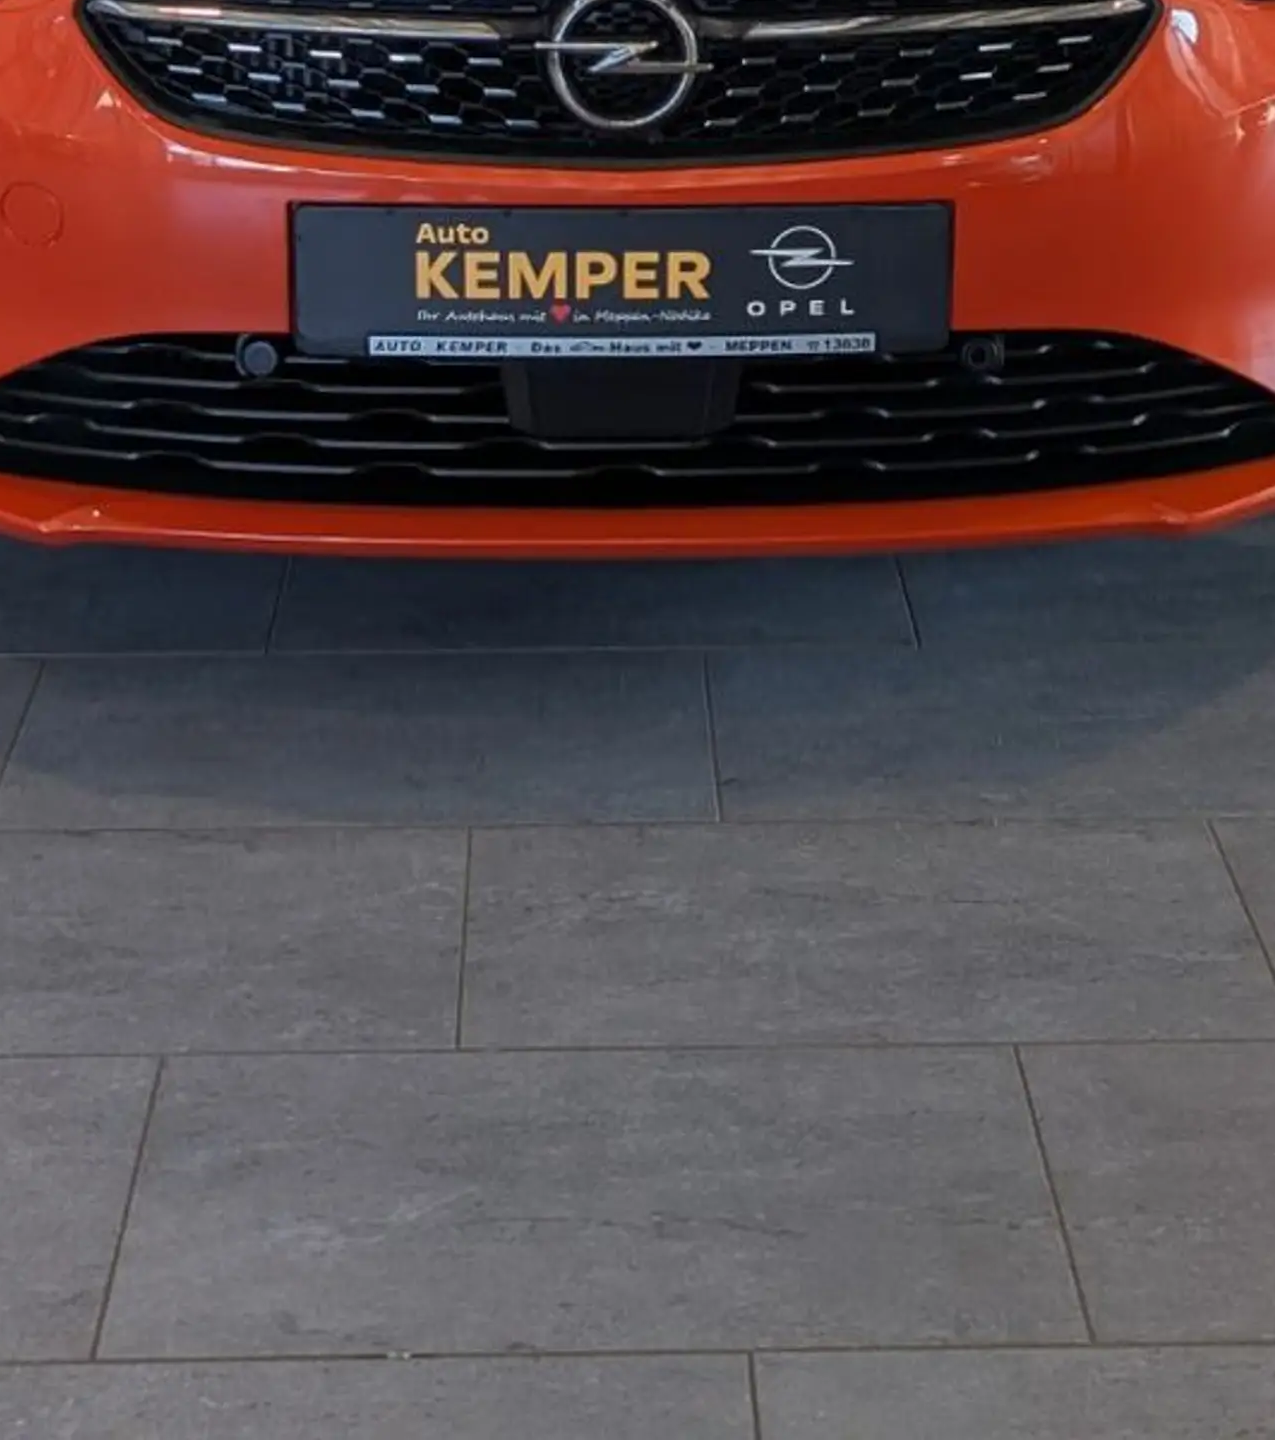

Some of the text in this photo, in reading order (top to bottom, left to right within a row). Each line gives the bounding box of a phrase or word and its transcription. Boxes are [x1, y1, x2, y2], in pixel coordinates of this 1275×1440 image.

[416, 222, 489, 245] Auto
[415, 250, 712, 300] KEMPER
[746, 298, 855, 317] OPEL
[374, 340, 422, 353] AUTO
[436, 340, 509, 354] KEMPER
[530, 341, 561, 354] Das
[610, 340, 651, 353] Haus
[656, 340, 682, 353] mit
[725, 339, 793, 352] MEPPEN
